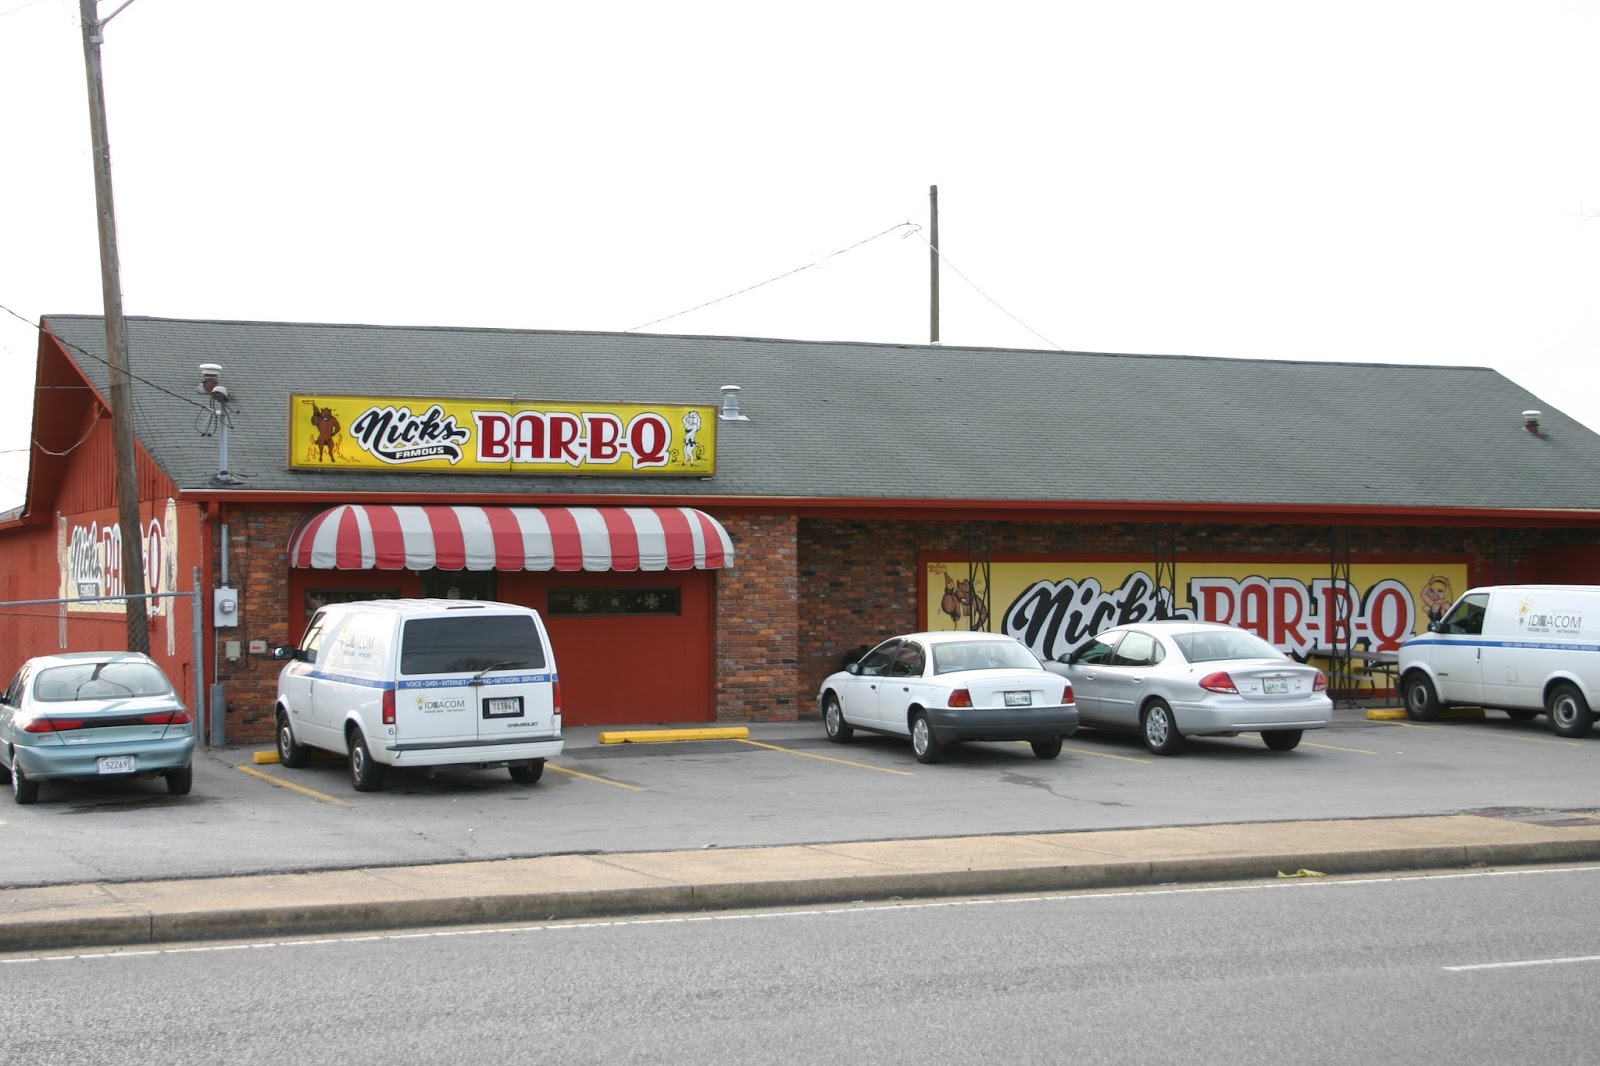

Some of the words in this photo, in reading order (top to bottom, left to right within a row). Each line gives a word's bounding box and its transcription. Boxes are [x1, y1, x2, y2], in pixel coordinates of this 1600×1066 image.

[353, 408, 467, 448] Nicks
[478, 413, 666, 463] BAR-B-Q
[395, 446, 444, 459] FAMOUS
[1199, 583, 1408, 653] BAR-B-Q
[495, 676, 520, 684] NETWORK
[521, 674, 545, 683] SERVICES
[106, 760, 127, 770] 52269
